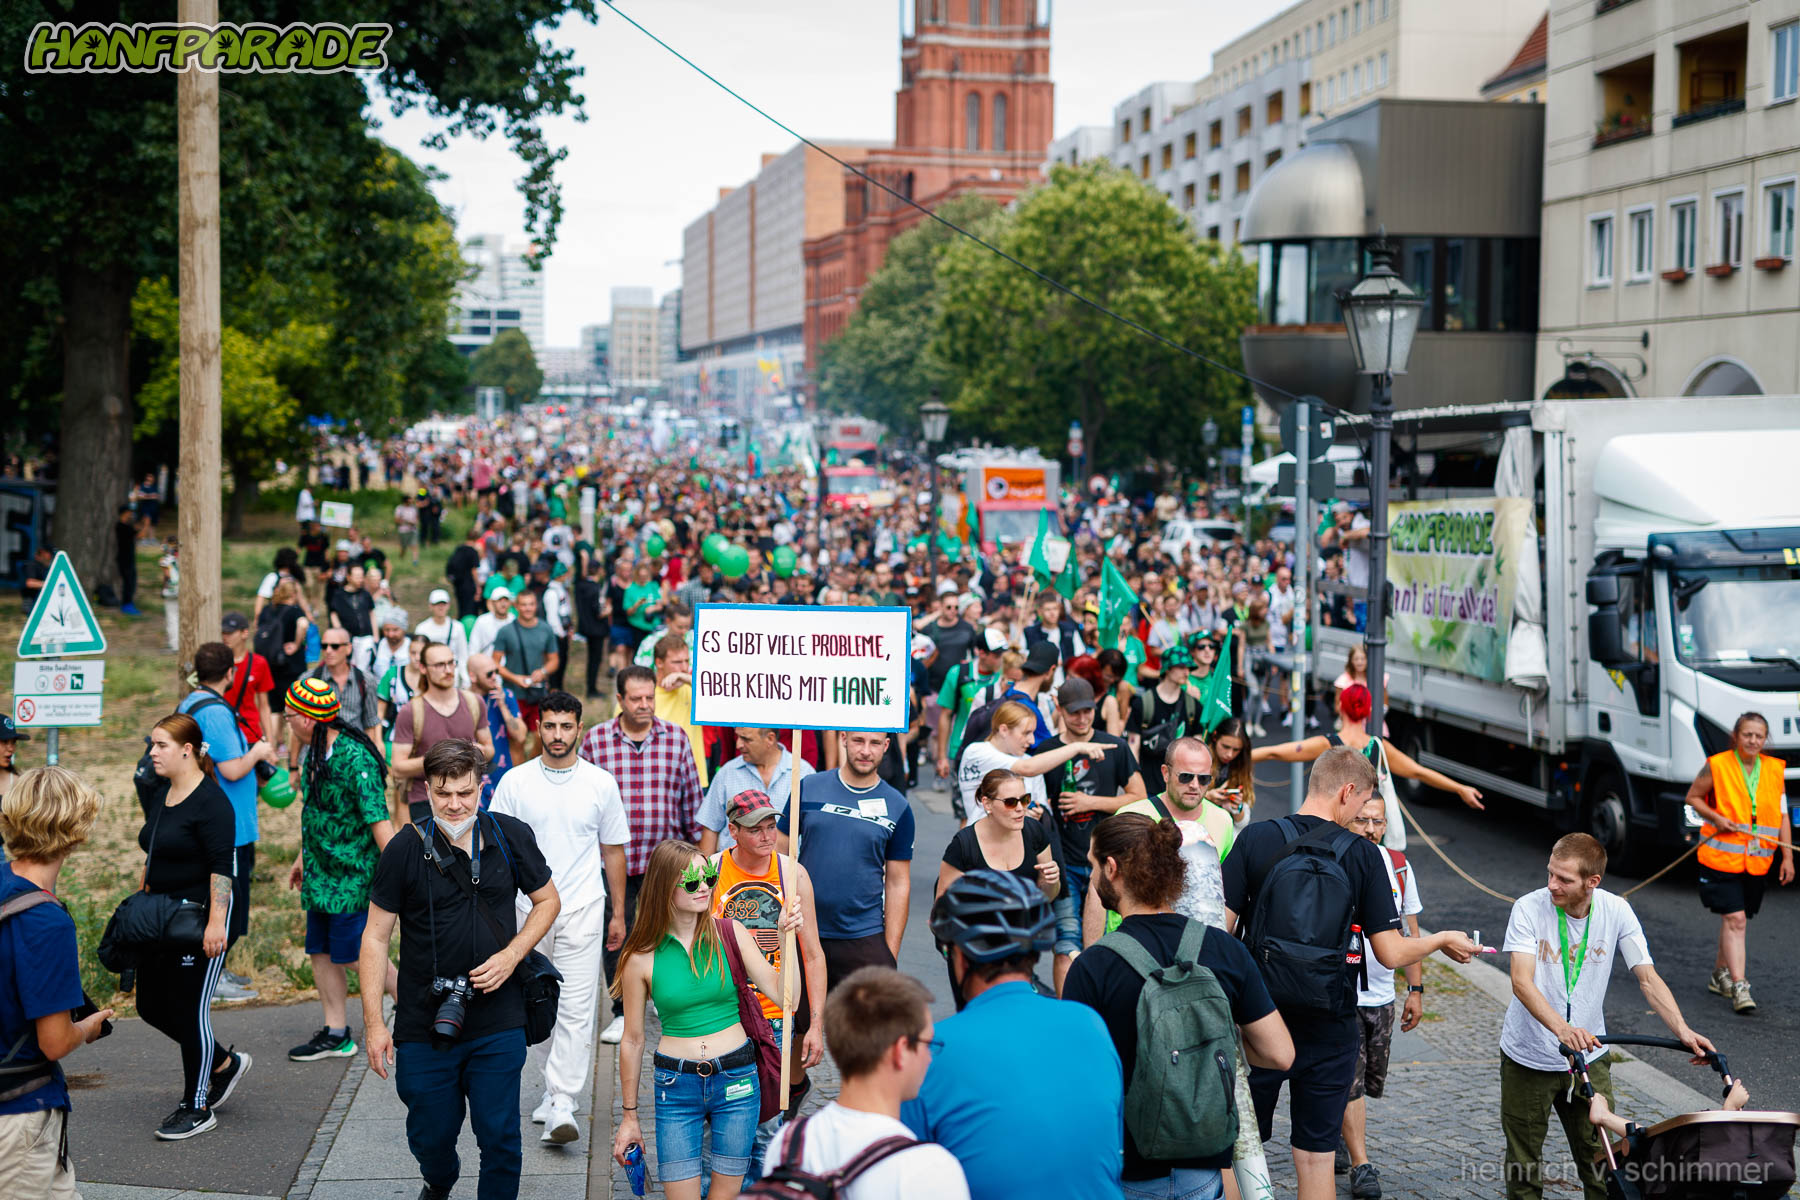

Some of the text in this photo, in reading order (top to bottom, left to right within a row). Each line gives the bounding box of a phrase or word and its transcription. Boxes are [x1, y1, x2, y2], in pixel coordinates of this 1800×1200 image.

[1390, 511, 1495, 555] HANFPARADE
[701, 630, 891, 662] ES GIBT VIELE PROBLEME,
[700, 670, 741, 698] ABER
[746, 672, 792, 701] KEINS
[799, 675, 828, 703] MIT
[724, 899, 760, 920] 932
